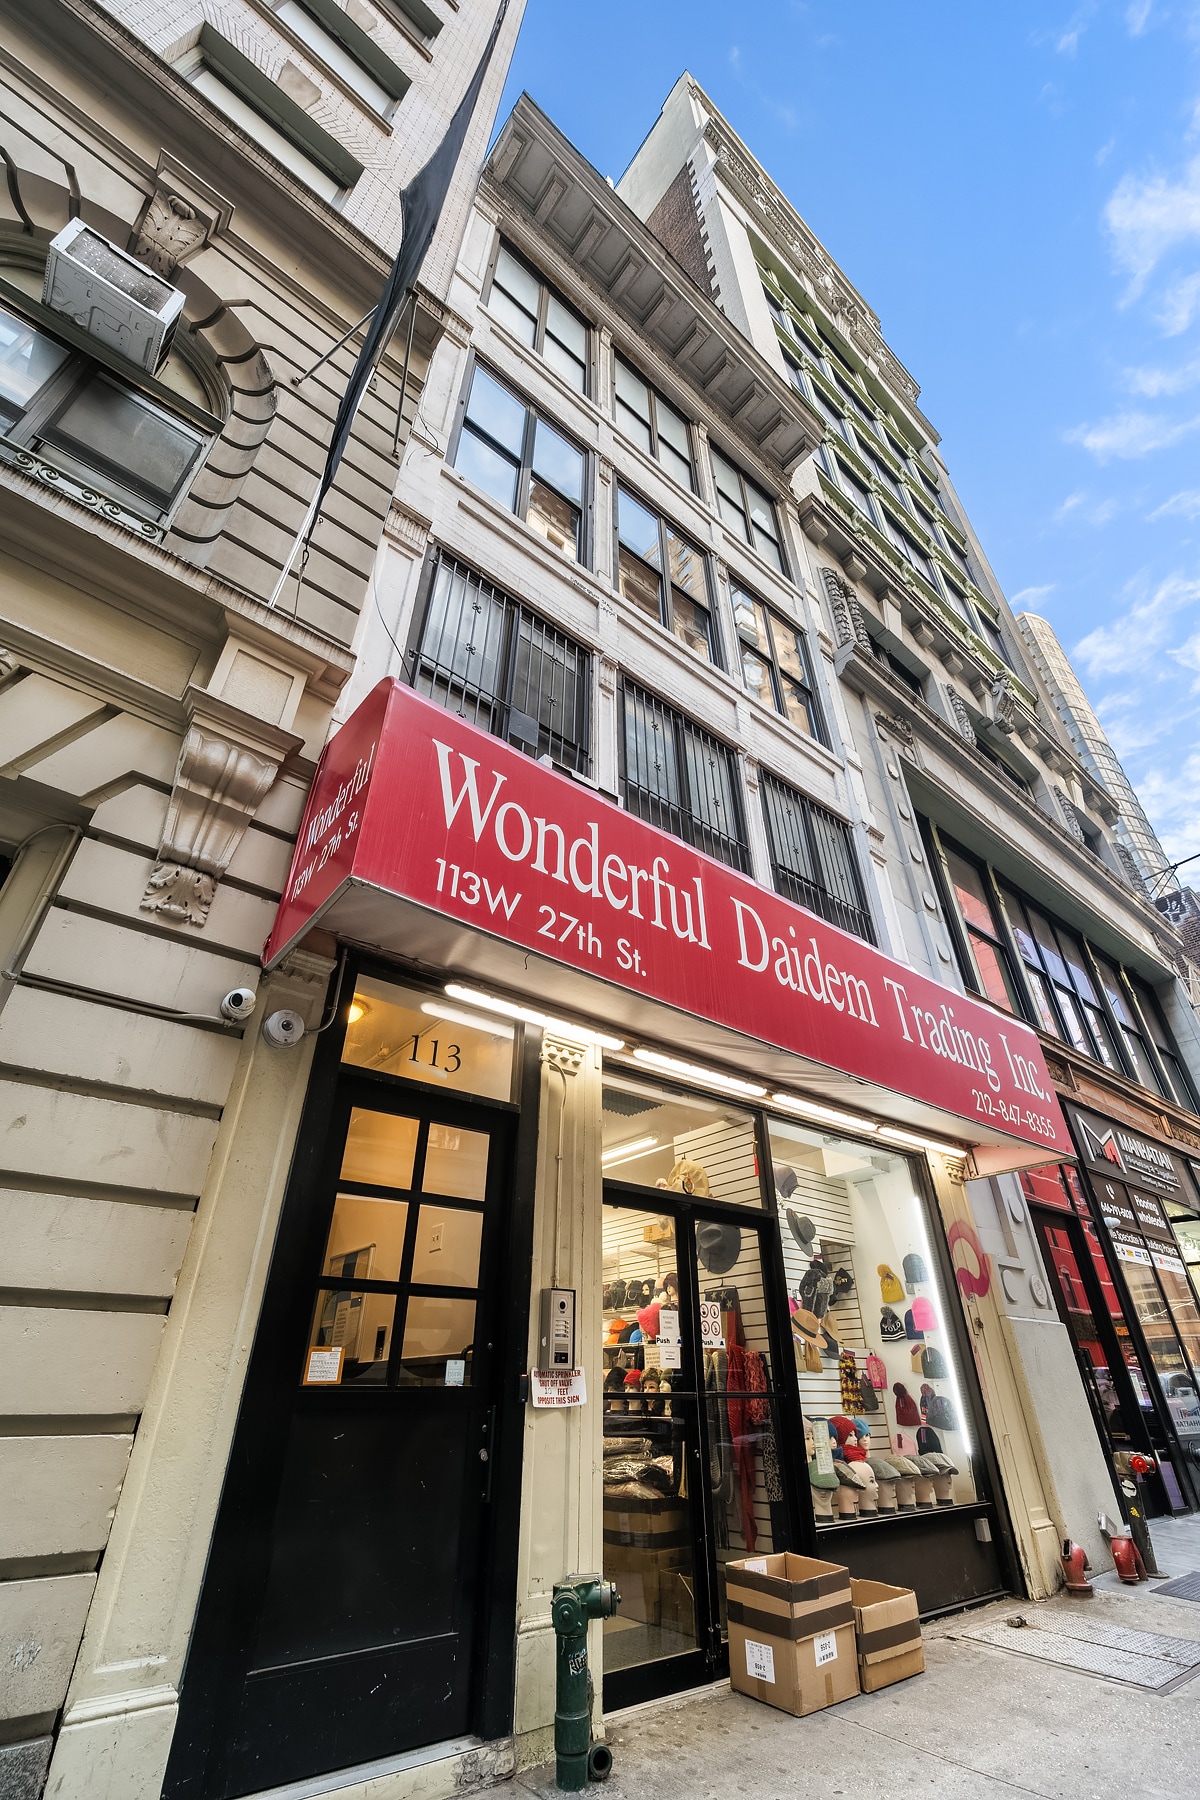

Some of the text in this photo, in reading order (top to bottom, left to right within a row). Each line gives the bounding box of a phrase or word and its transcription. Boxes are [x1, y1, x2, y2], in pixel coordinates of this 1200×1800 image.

[305, 741, 376, 856] Wonderful
[317, 826, 342, 873] 27th
[431, 738, 1052, 1103] Wonderful Daidem Trading Inc.
[435, 858, 647, 977] 113W 27th St.
[408, 1034, 462, 1074] 113
[971, 1089, 1056, 1140] 212-847-8355
[1116, 1132, 1175, 1172] MANHATTAN
[1133, 1194, 1160, 1216] Flooring
[1137, 1211, 1167, 1229] wholesale
[1116, 1230, 1139, 1245] Specialize
[534, 1370, 581, 1379] AUTOMATIC SPRINKLER
[540, 1379, 573, 1387] SHUT OFF VALVE
[537, 1395, 580, 1405] OPPOSITE THIS SIGN
[557, 1388, 569, 1396] FEET
